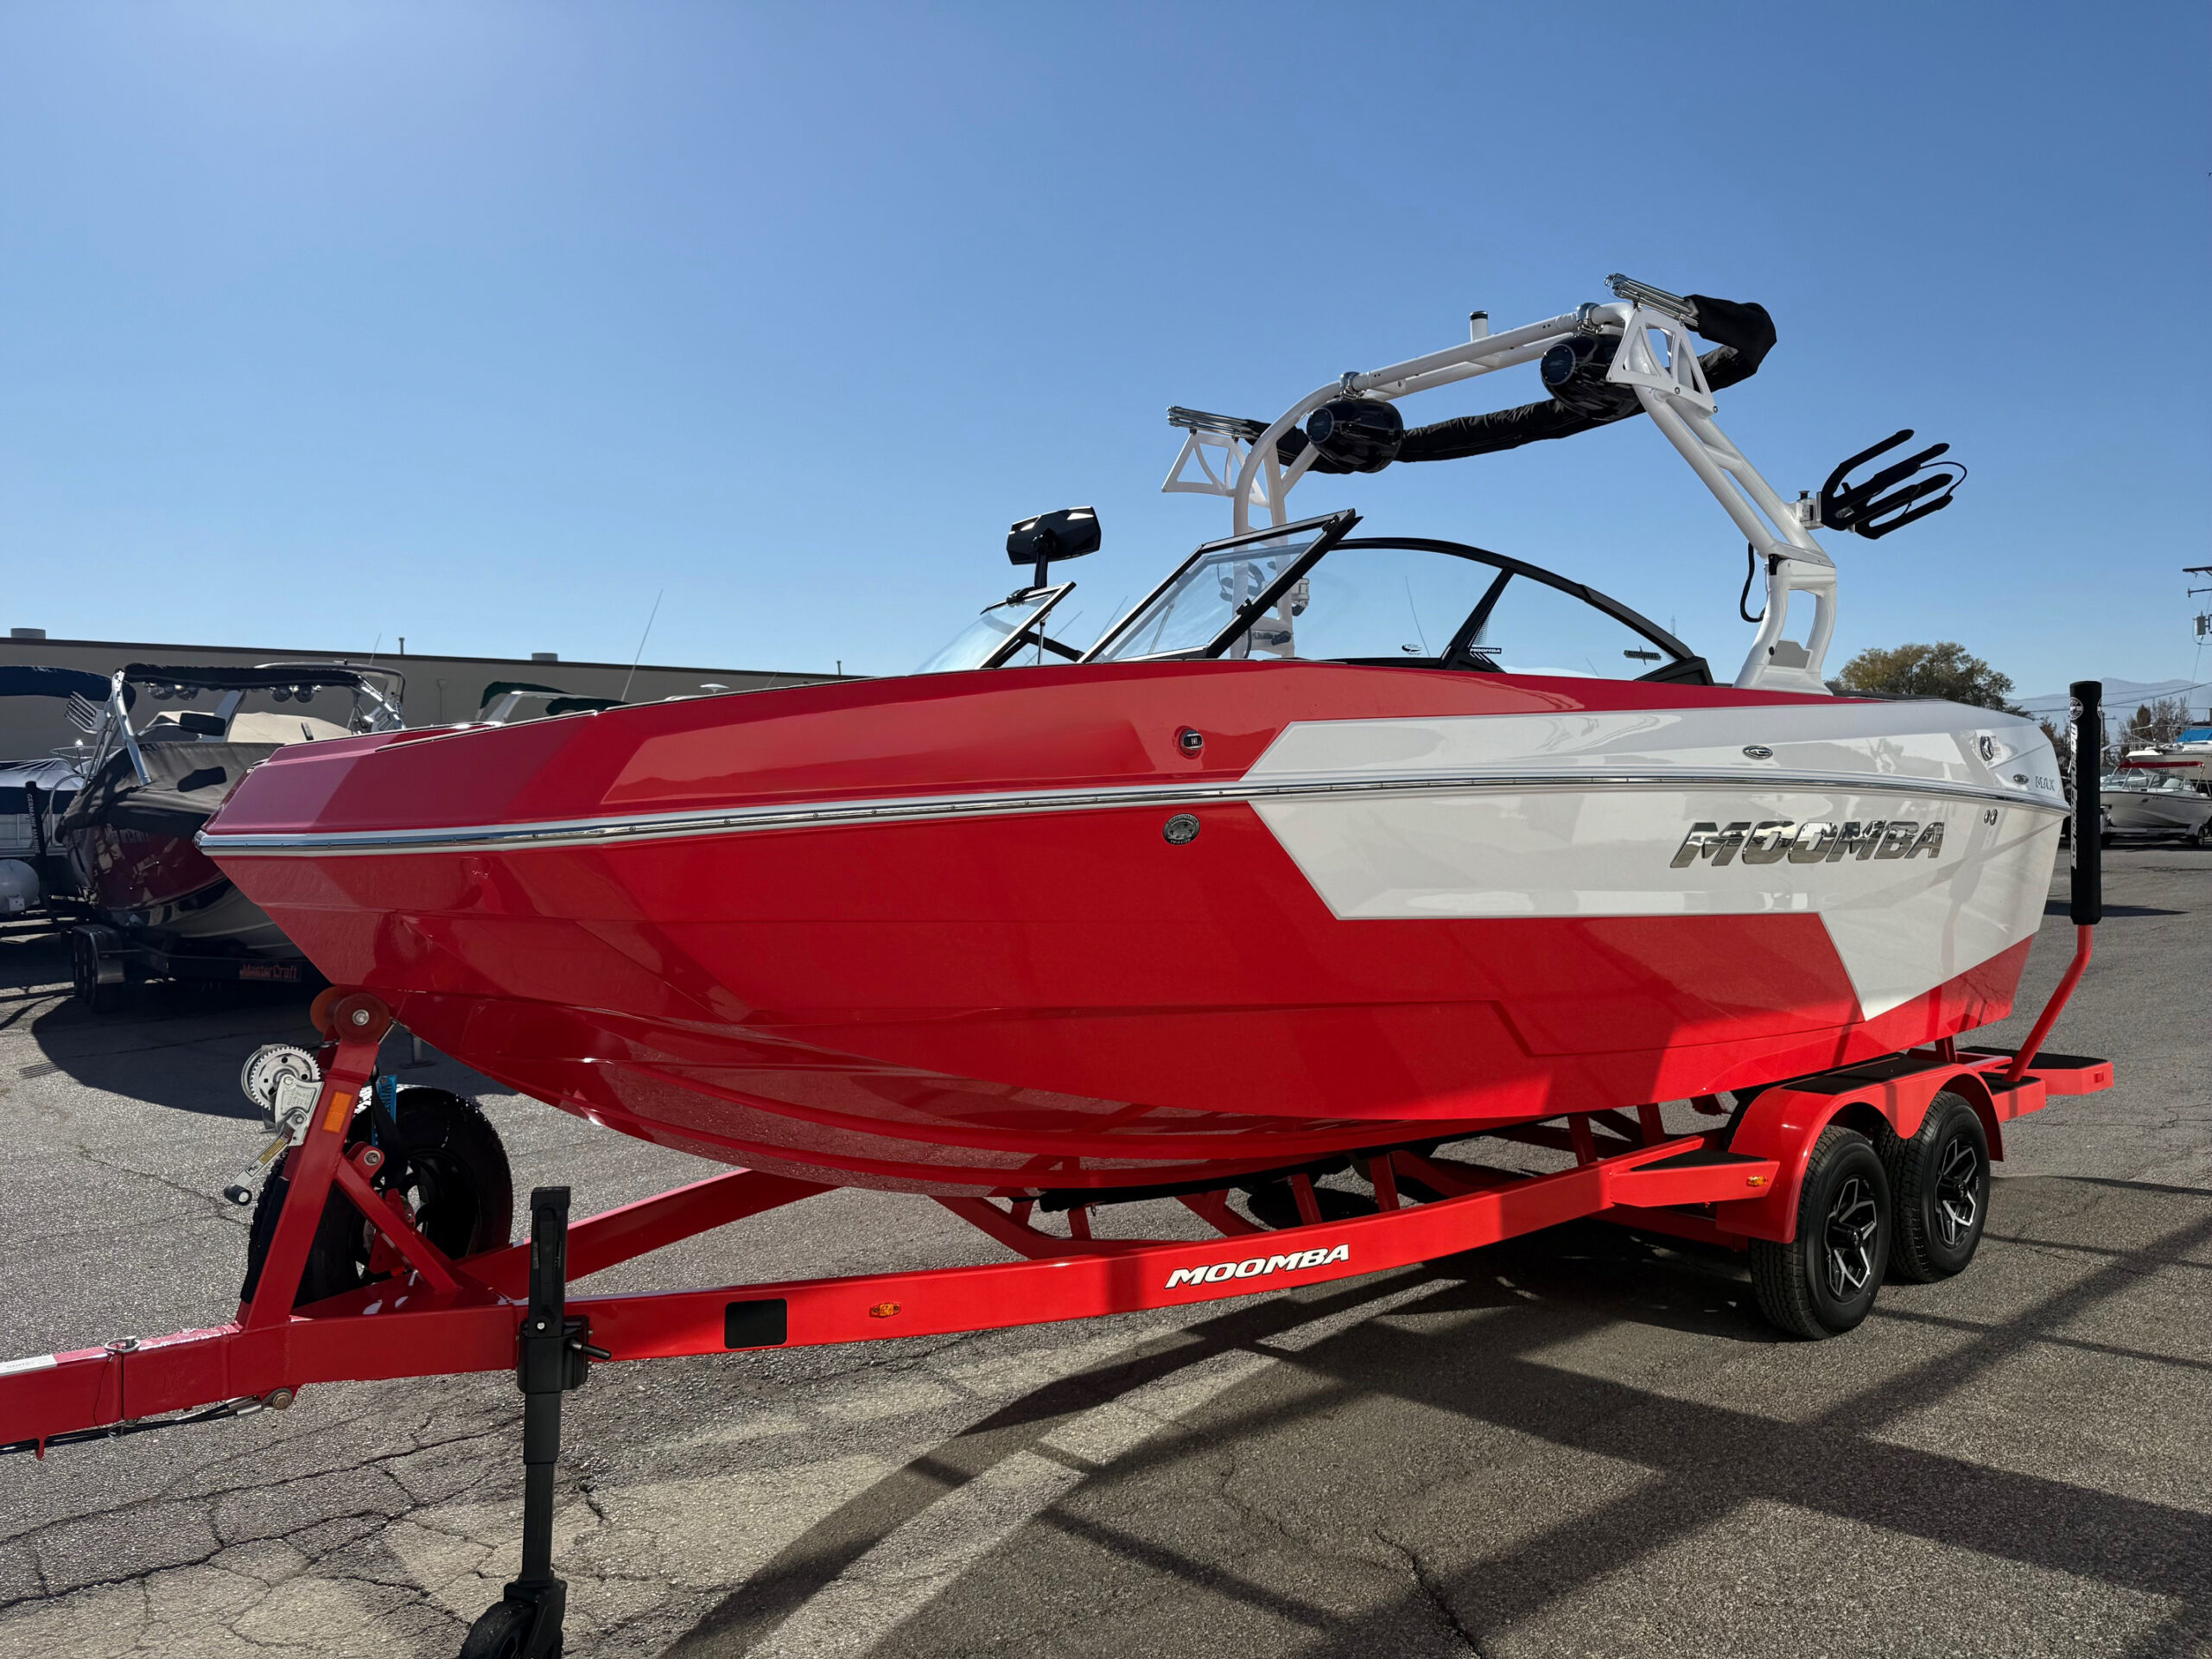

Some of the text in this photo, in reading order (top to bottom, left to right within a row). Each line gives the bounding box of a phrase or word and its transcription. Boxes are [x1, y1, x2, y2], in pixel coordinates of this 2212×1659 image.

[1669, 820, 1945, 868] MOOMBA
[239, 963, 297, 979] MasterCraft
[1164, 1243, 1350, 1289] MOOMBA
